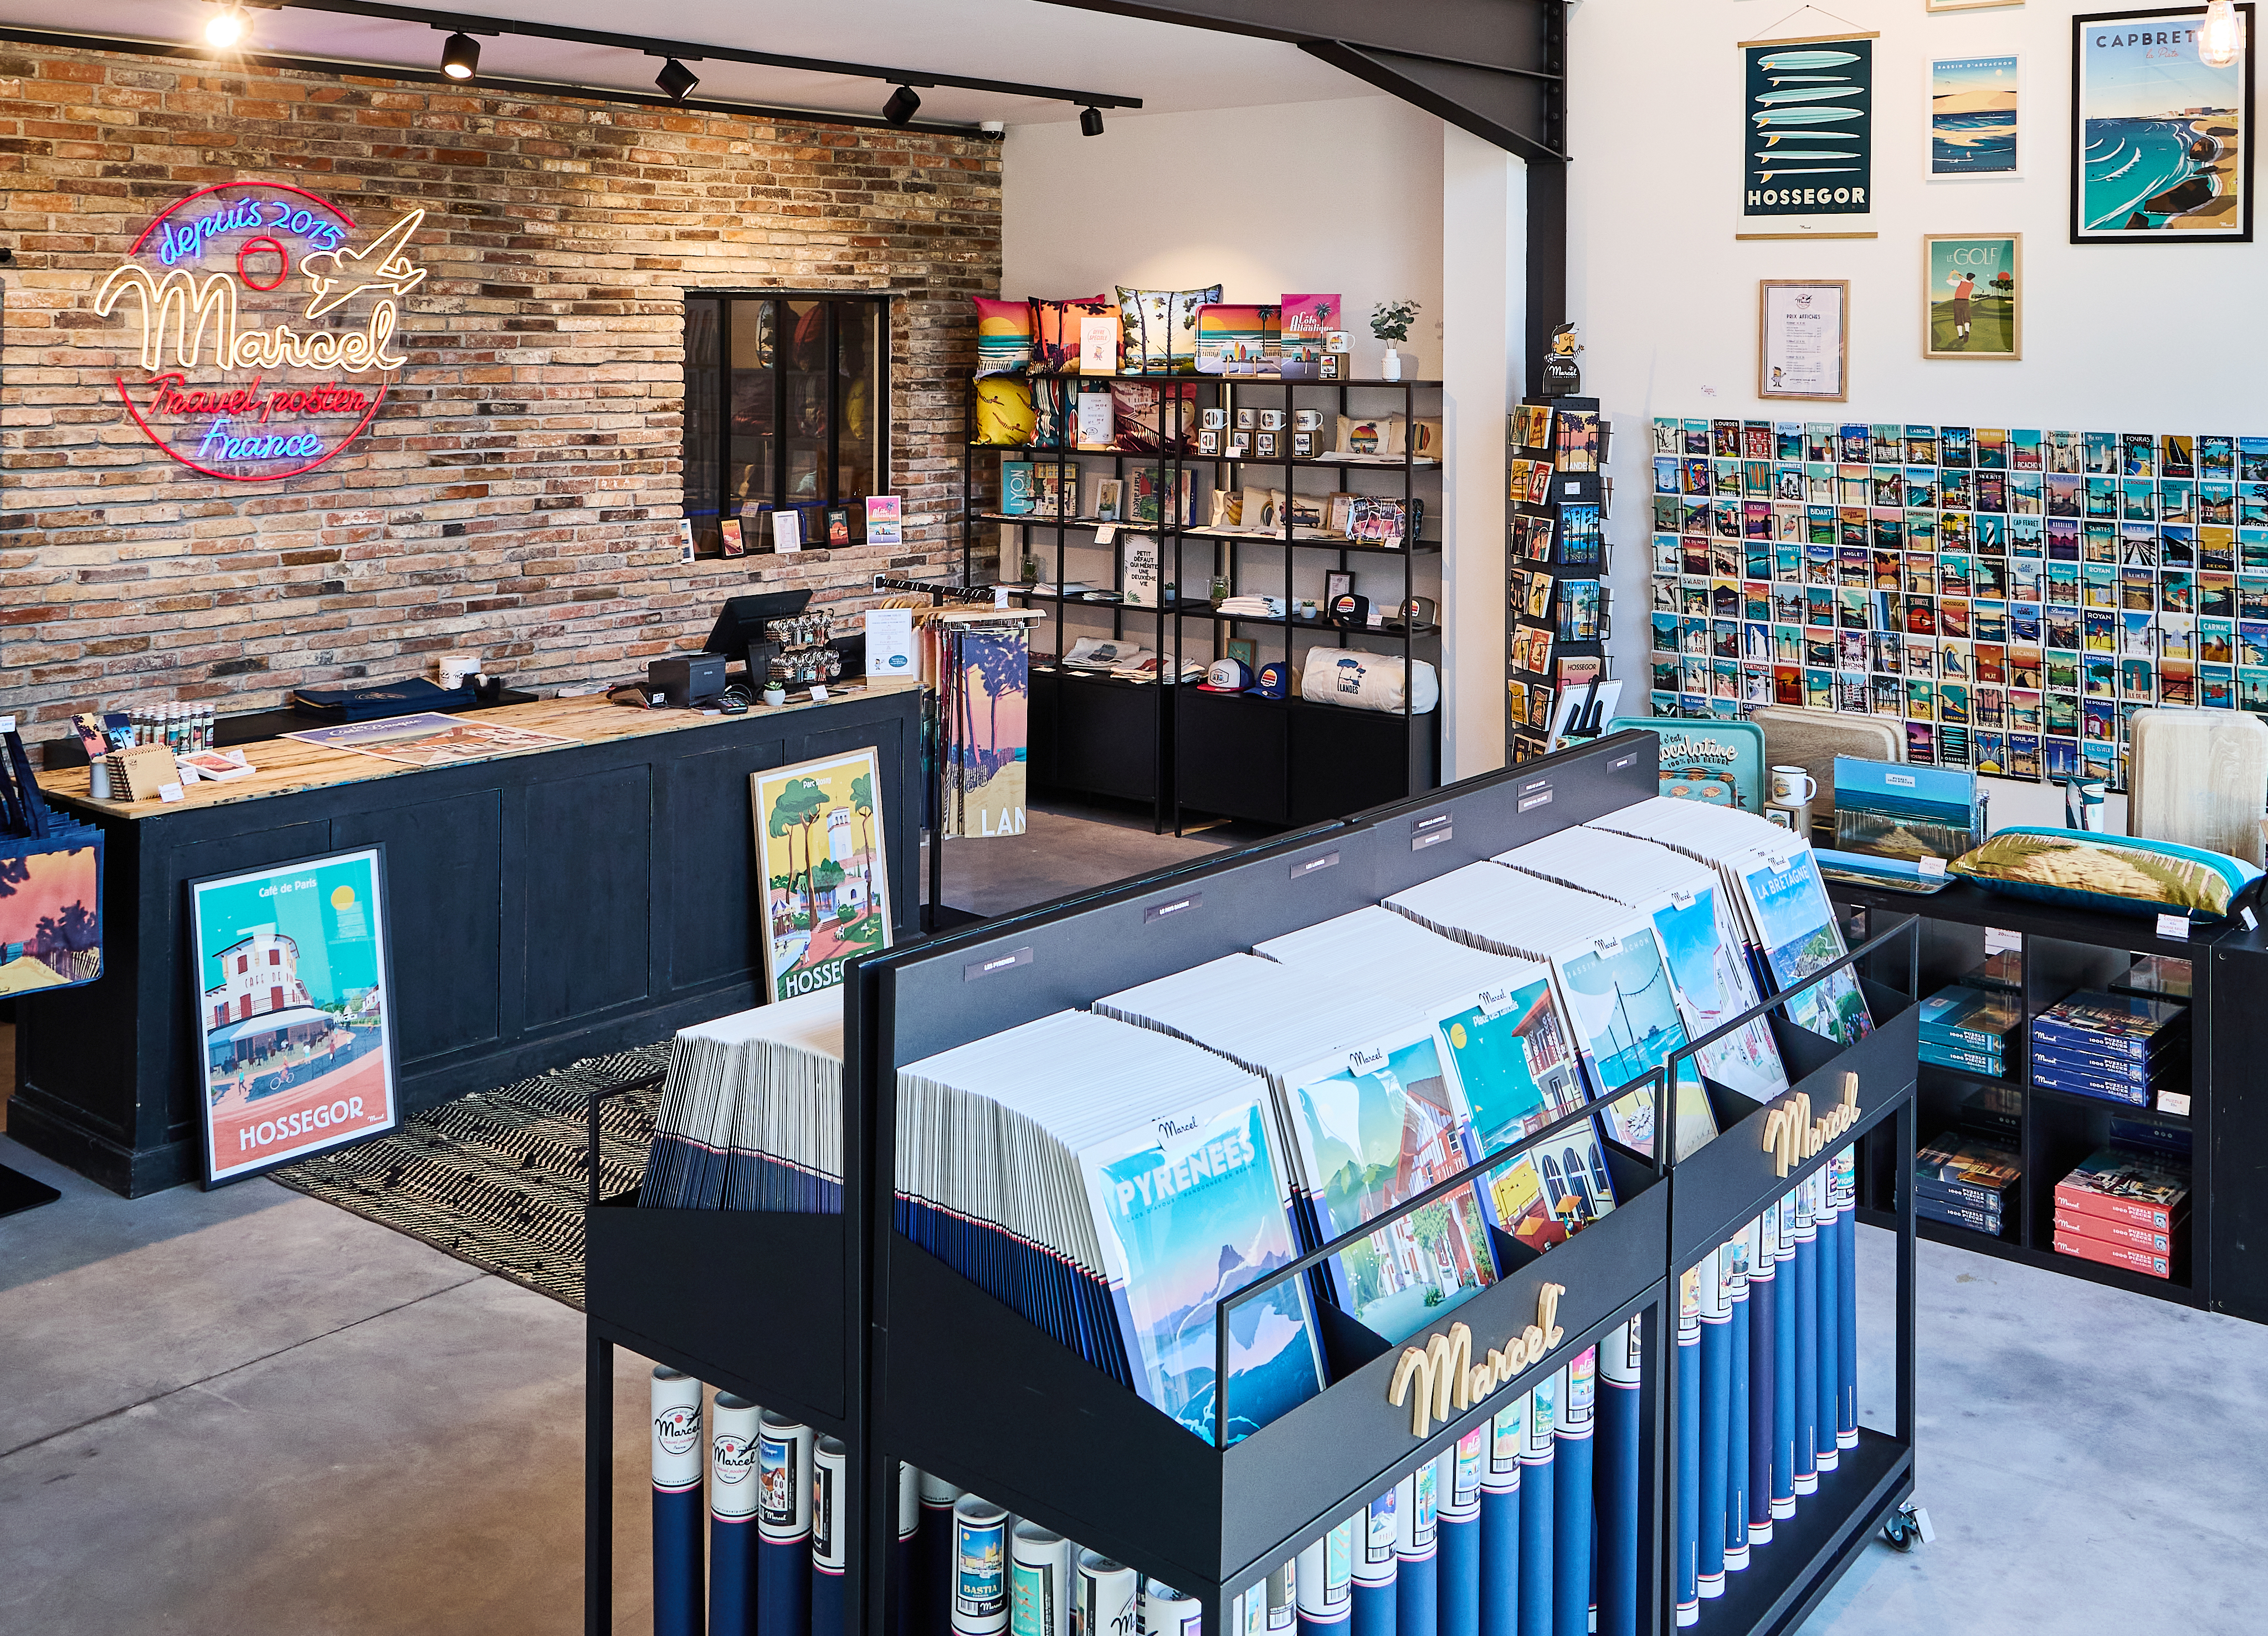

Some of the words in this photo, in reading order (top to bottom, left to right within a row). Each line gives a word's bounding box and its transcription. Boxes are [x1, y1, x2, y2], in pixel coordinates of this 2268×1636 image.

[2096, 30, 2196, 48] CAPBRET
[2146, 48, 2154, 59] la
[2158, 47, 2179, 58] Piste
[1748, 187, 1866, 206] HOSSEGOR
[160, 196, 264, 266] depuis
[268, 201, 346, 251] 2015
[1953, 247, 1998, 265] GOLF
[93, 264, 409, 372] Marcel
[1290, 315, 1333, 333] Atlantique
[1299, 311, 1317, 324] Côte
[1549, 366, 1578, 376] Marcel
[147, 372, 263, 416] Travel
[259, 381, 370, 424] poster
[197, 418, 324, 459] France
[1010, 470, 1025, 507] LYON
[1131, 471, 1142, 518] Marrakech
[2203, 623, 2229, 632] CARNAC
[1340, 686, 1359, 695] LANDES
[364, 719, 423, 732] Basque
[1664, 734, 1682, 744] c'est
[1659, 735, 1739, 762] ocolatine
[1667, 758, 1686, 768] 100%
[1687, 757, 1701, 765] PUR
[1703, 756, 1730, 767] BEURRE
[803, 779, 815, 789] Parc
[815, 776, 832, 787] Rosny
[981, 805, 1027, 836] LAN
[1768, 856, 1786, 868] Marcel
[259, 886, 278, 898] Café
[280, 884, 292, 894] de
[294, 878, 317, 891] Paris
[1756, 884, 1770, 900] LA
[1768, 865, 1810, 895] BRETAGNE
[1671, 890, 1691, 904] Marcel
[1594, 937, 1619, 952] Marcel
[786, 950, 875, 998] HOSSE
[1567, 961, 1596, 979] BASSIN
[245, 971, 265, 988] CAFE
[272, 971, 281, 984] DE
[1479, 988, 1507, 1006] Marcel
[1472, 1014, 1489, 1028] Place
[1964, 1030, 1986, 1039] PUZZLE
[2034, 1030, 2057, 1043] Marcel
[2104, 1036, 2128, 1045] PUZZLE
[1349, 1048, 1383, 1068] Marcel
[2034, 1053, 2057, 1065] Marcel
[2035, 1074, 2058, 1087] Marcel
[239, 1096, 364, 1151] HOSSEGOR
[367, 1113, 384, 1123] Marcel
[1763, 1070, 1861, 1178] Marcel
[1158, 1116, 1199, 1139] Marcel
[1115, 1135, 1255, 1217] PYRENEES
[1962, 1188, 1985, 1197] PUZZLE
[1127, 1211, 1143, 1223] LACS
[1146, 1198, 1175, 1214] D'AYOUS
[2057, 1197, 2080, 1209] Marcel
[2127, 1206, 2152, 1215] PUZZLE
[2057, 1218, 2081, 1232] Marcel
[2057, 1242, 2080, 1254] Marcel
[1389, 1282, 1566, 1439] Marcel
[654, 1416, 701, 1438] Marcel
[679, 1436, 696, 1445] posters
[712, 1442, 756, 1466] Marcel
[764, 1511, 787, 1522] Marcel
[963, 1584, 998, 1595] BASTIA
[979, 1599, 1003, 1612] Marcel
